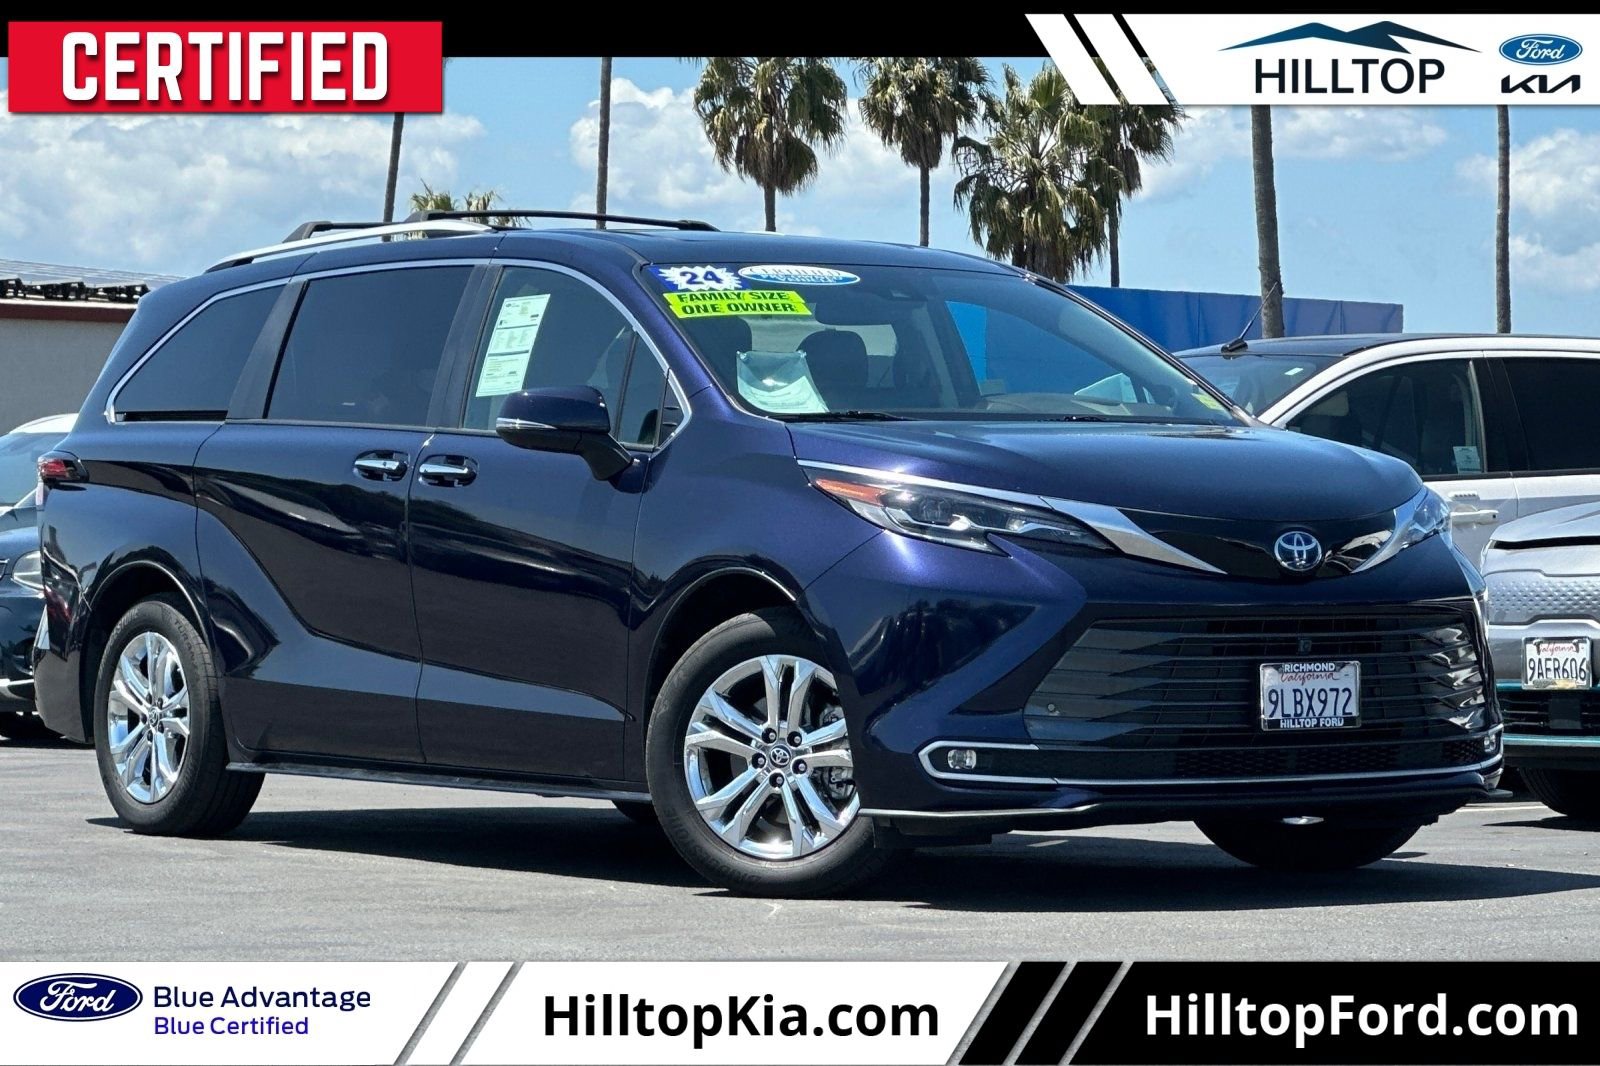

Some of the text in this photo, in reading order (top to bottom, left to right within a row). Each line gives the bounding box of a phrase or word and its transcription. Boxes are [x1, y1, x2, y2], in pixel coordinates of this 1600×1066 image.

[679, 270, 724, 286] 24
[677, 290, 789, 304] FAMILY SIZE
[681, 302, 797, 315] ONE OWNER
[1284, 662, 1336, 673] RICHMOND
[1280, 671, 1340, 686] California
[1267, 687, 1353, 718] 9LBX972
[1280, 717, 1345, 729] HILLTOP FORD
